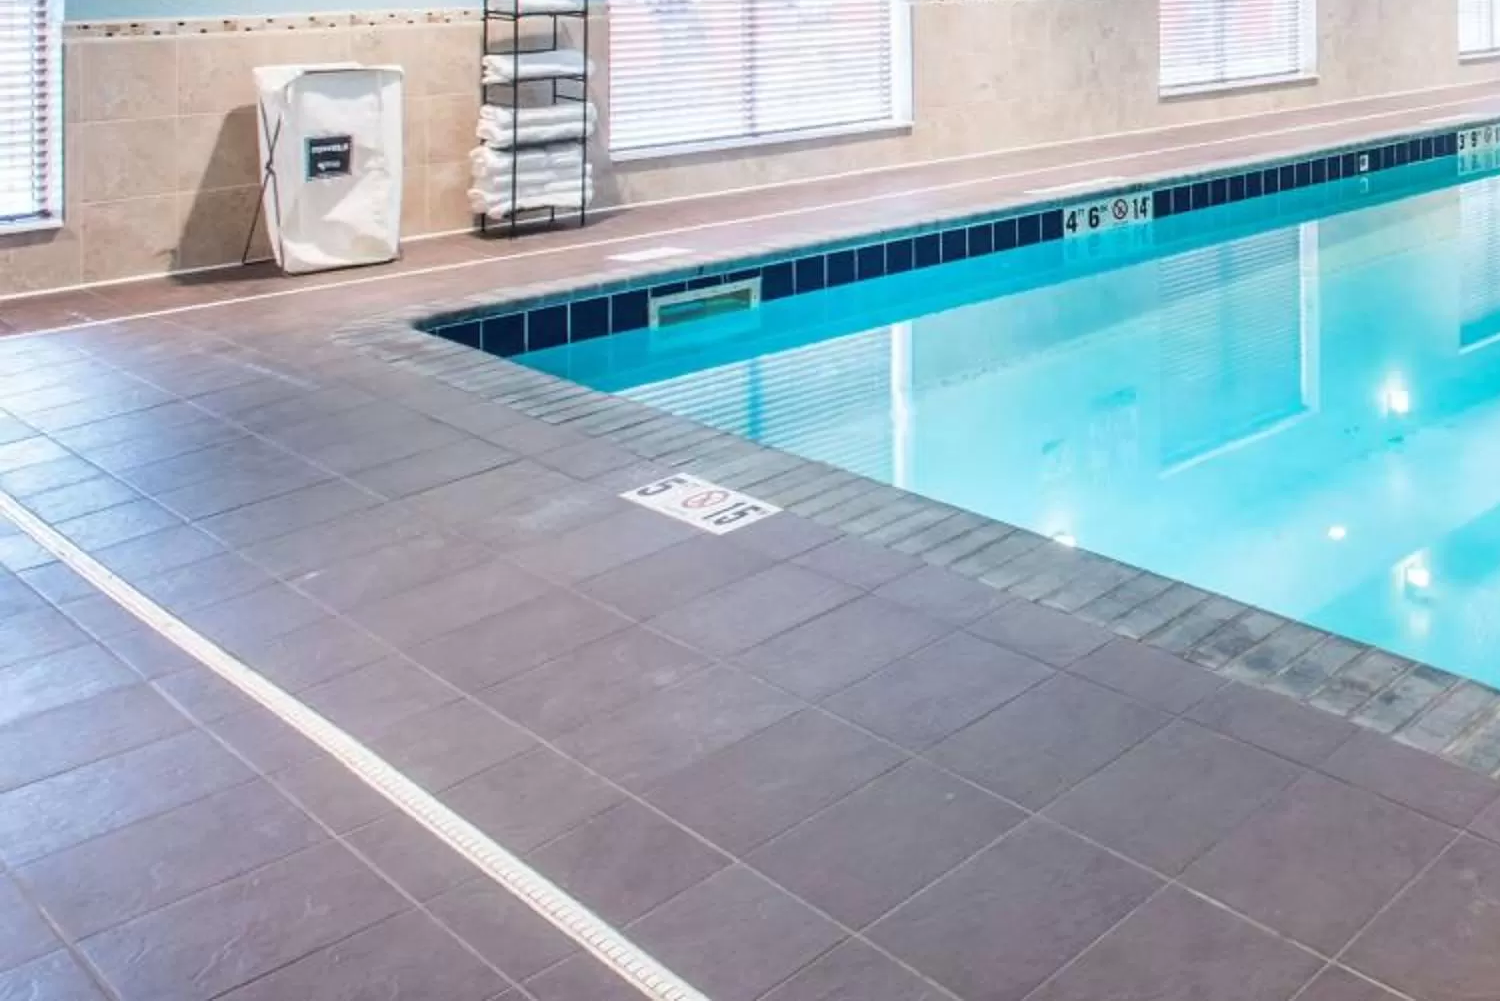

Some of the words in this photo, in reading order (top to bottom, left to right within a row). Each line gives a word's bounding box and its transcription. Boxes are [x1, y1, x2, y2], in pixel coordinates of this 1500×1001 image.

[1065, 209, 1078, 234] 4
[1088, 206, 1100, 229] 6
[636, 476, 688, 498] 5
